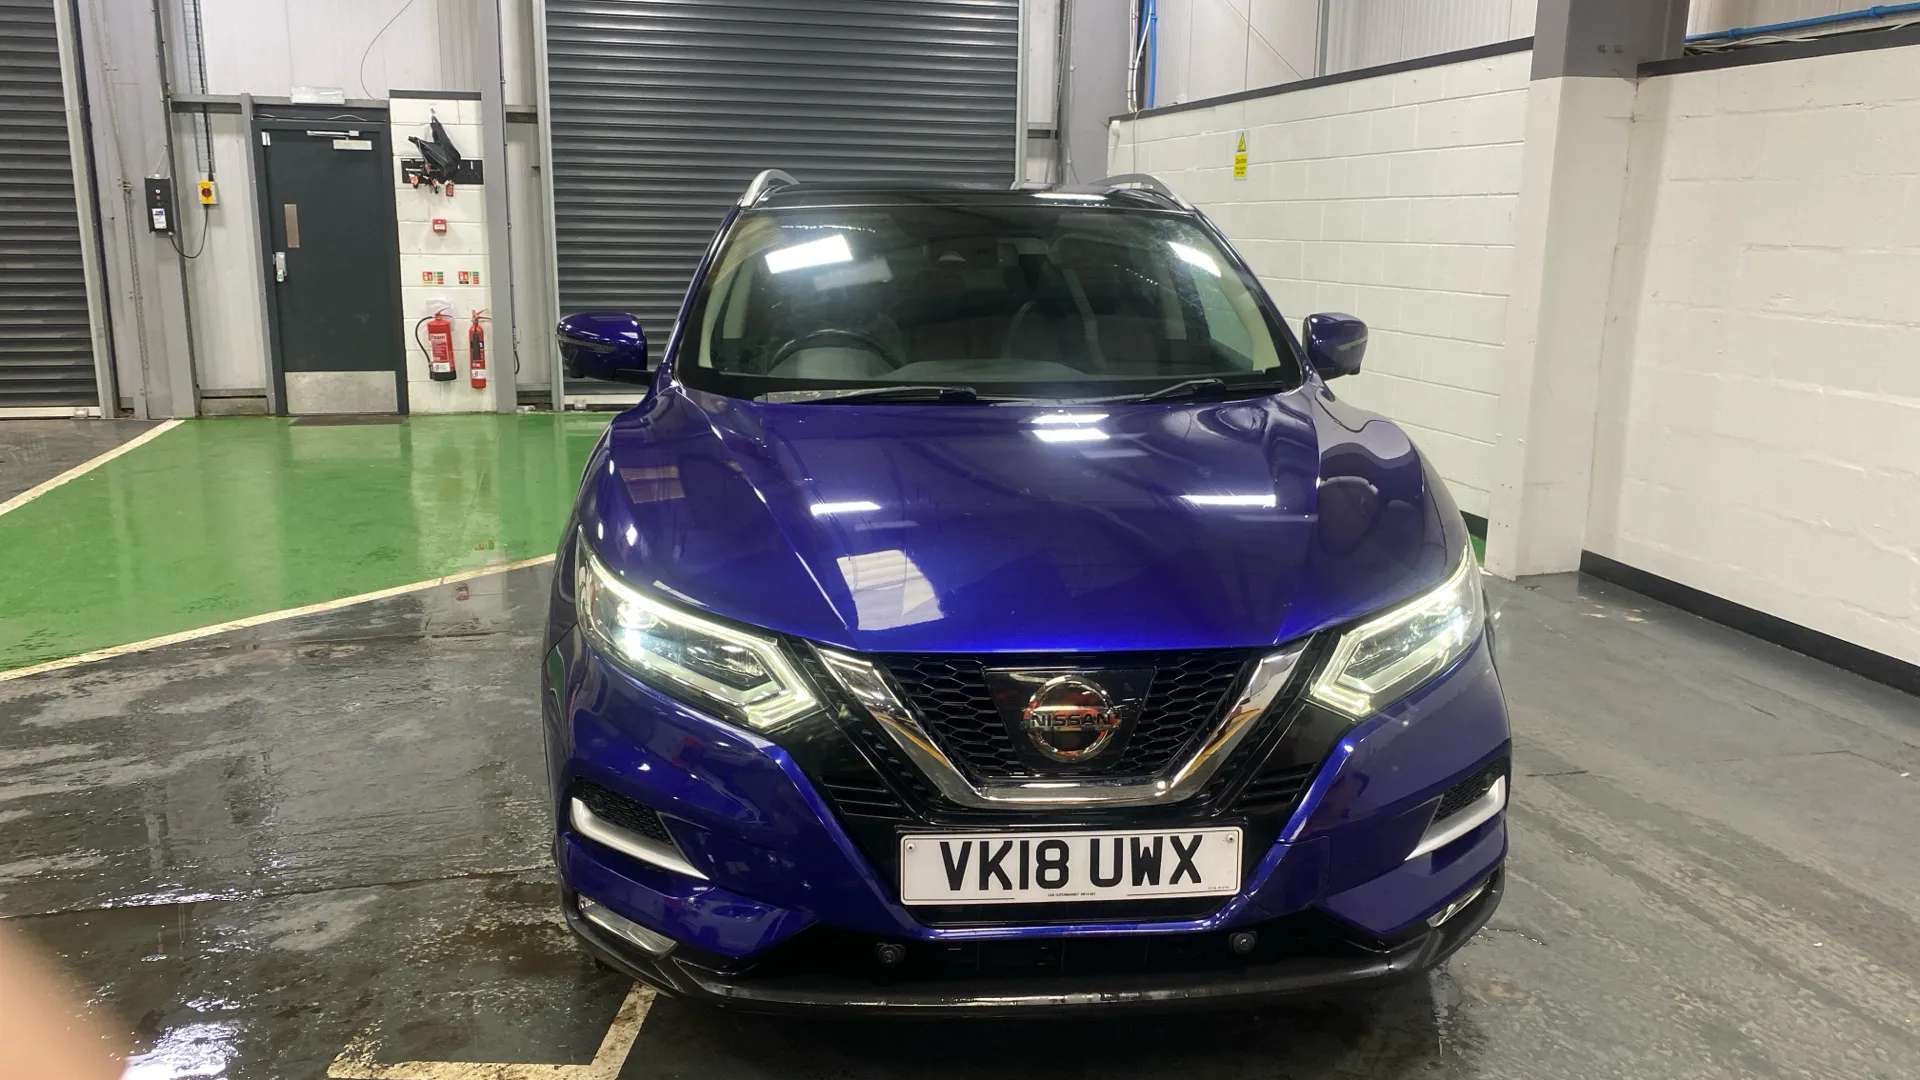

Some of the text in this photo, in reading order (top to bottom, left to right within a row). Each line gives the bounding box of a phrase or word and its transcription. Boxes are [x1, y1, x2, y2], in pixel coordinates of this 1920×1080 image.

[1030, 713, 1110, 727] NISSAN
[939, 834, 1203, 891] VK18 UWX
